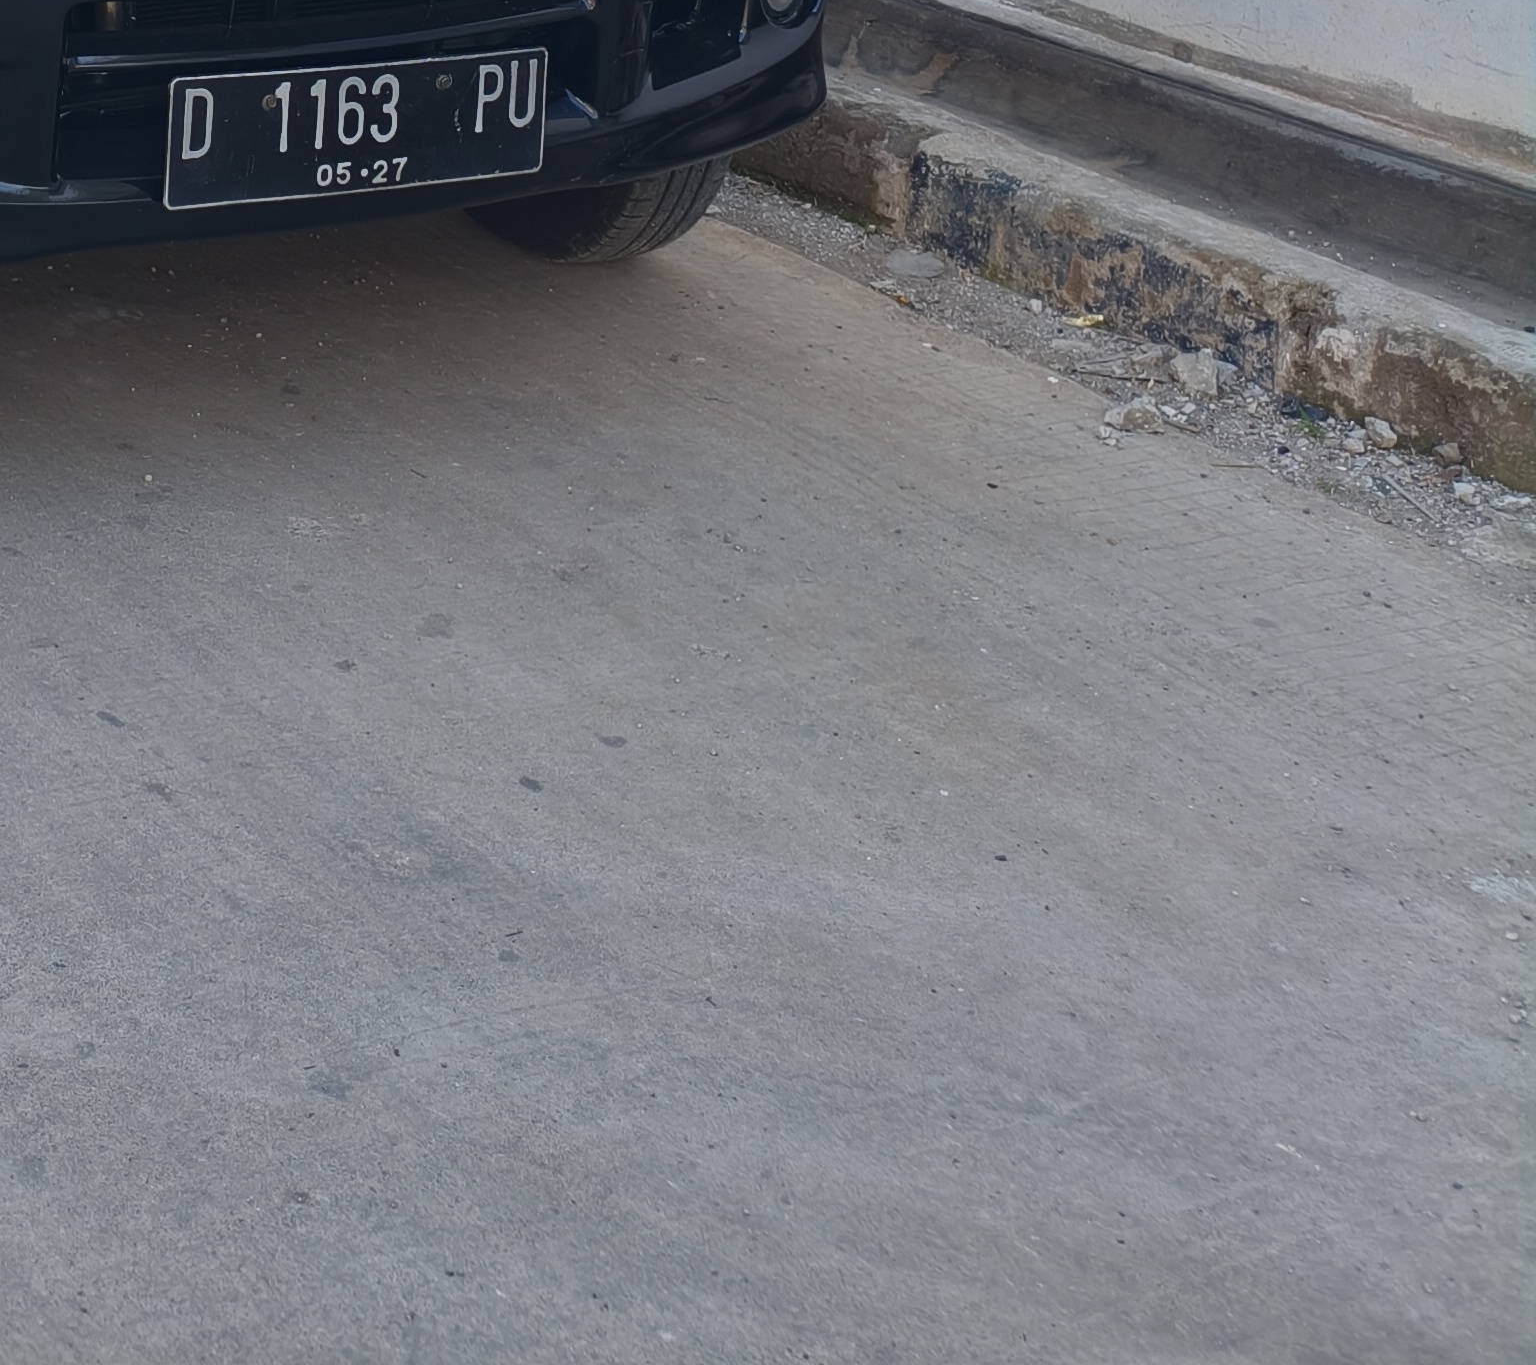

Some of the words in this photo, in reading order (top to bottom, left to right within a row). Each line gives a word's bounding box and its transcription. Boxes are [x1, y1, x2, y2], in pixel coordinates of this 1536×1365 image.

[181, 87, 215, 160] D
[274, 73, 400, 153] 1163
[473, 58, 539, 134] PU
